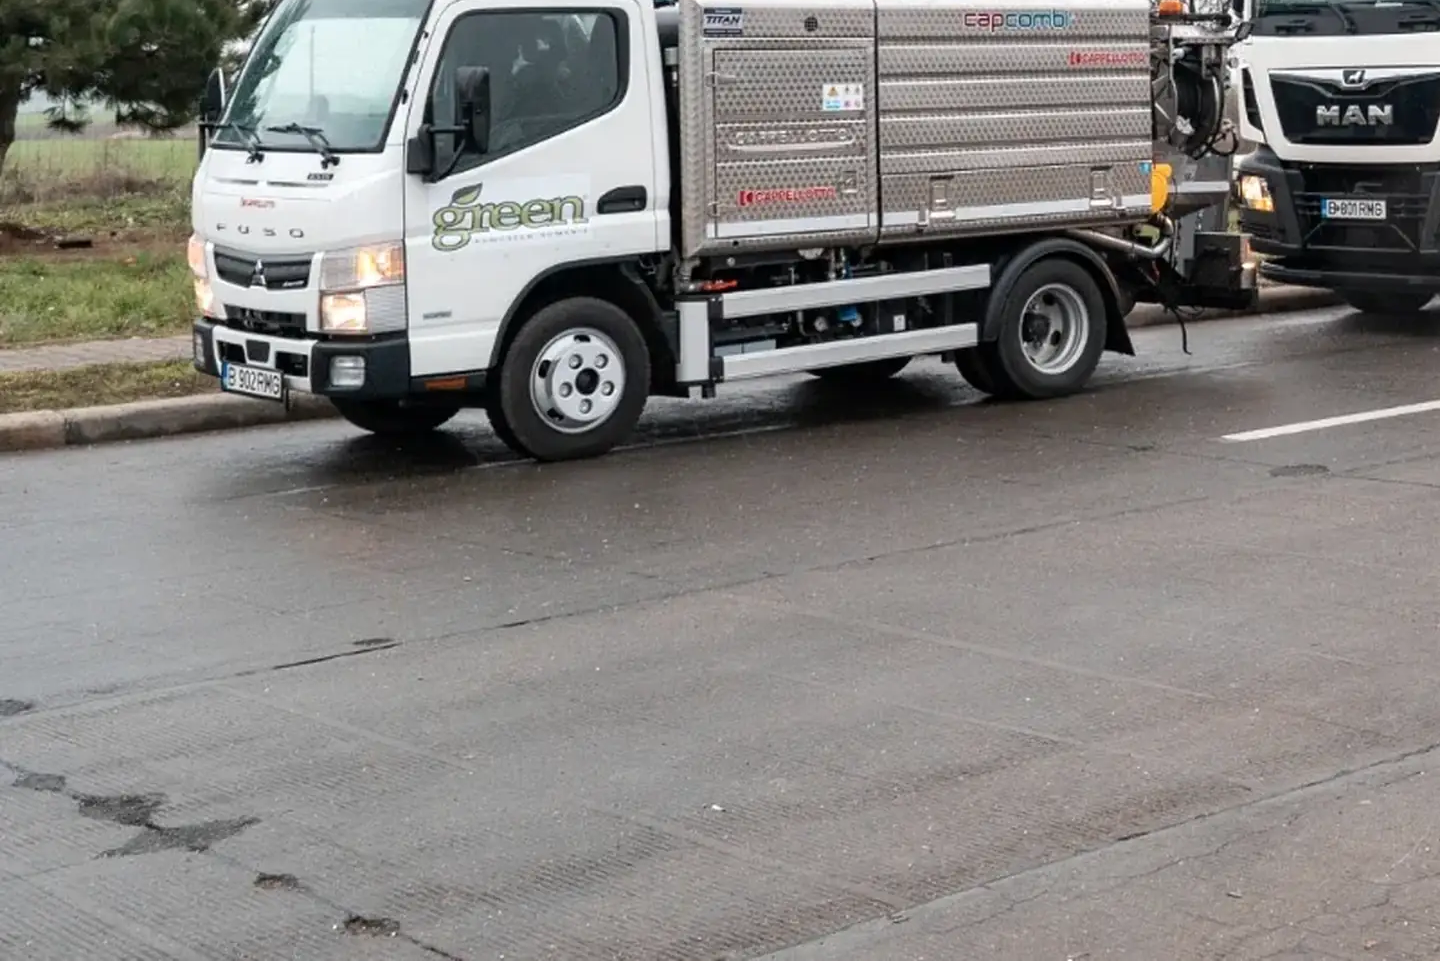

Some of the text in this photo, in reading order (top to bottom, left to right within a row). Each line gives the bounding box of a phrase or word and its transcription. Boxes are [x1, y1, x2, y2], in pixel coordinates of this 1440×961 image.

[706, 15, 741, 24] TITAN
[1316, 104, 1393, 126] MAN
[755, 188, 836, 204] CAPPELLOTTO
[216, 223, 304, 239] FUSO
[431, 195, 589, 251] green
